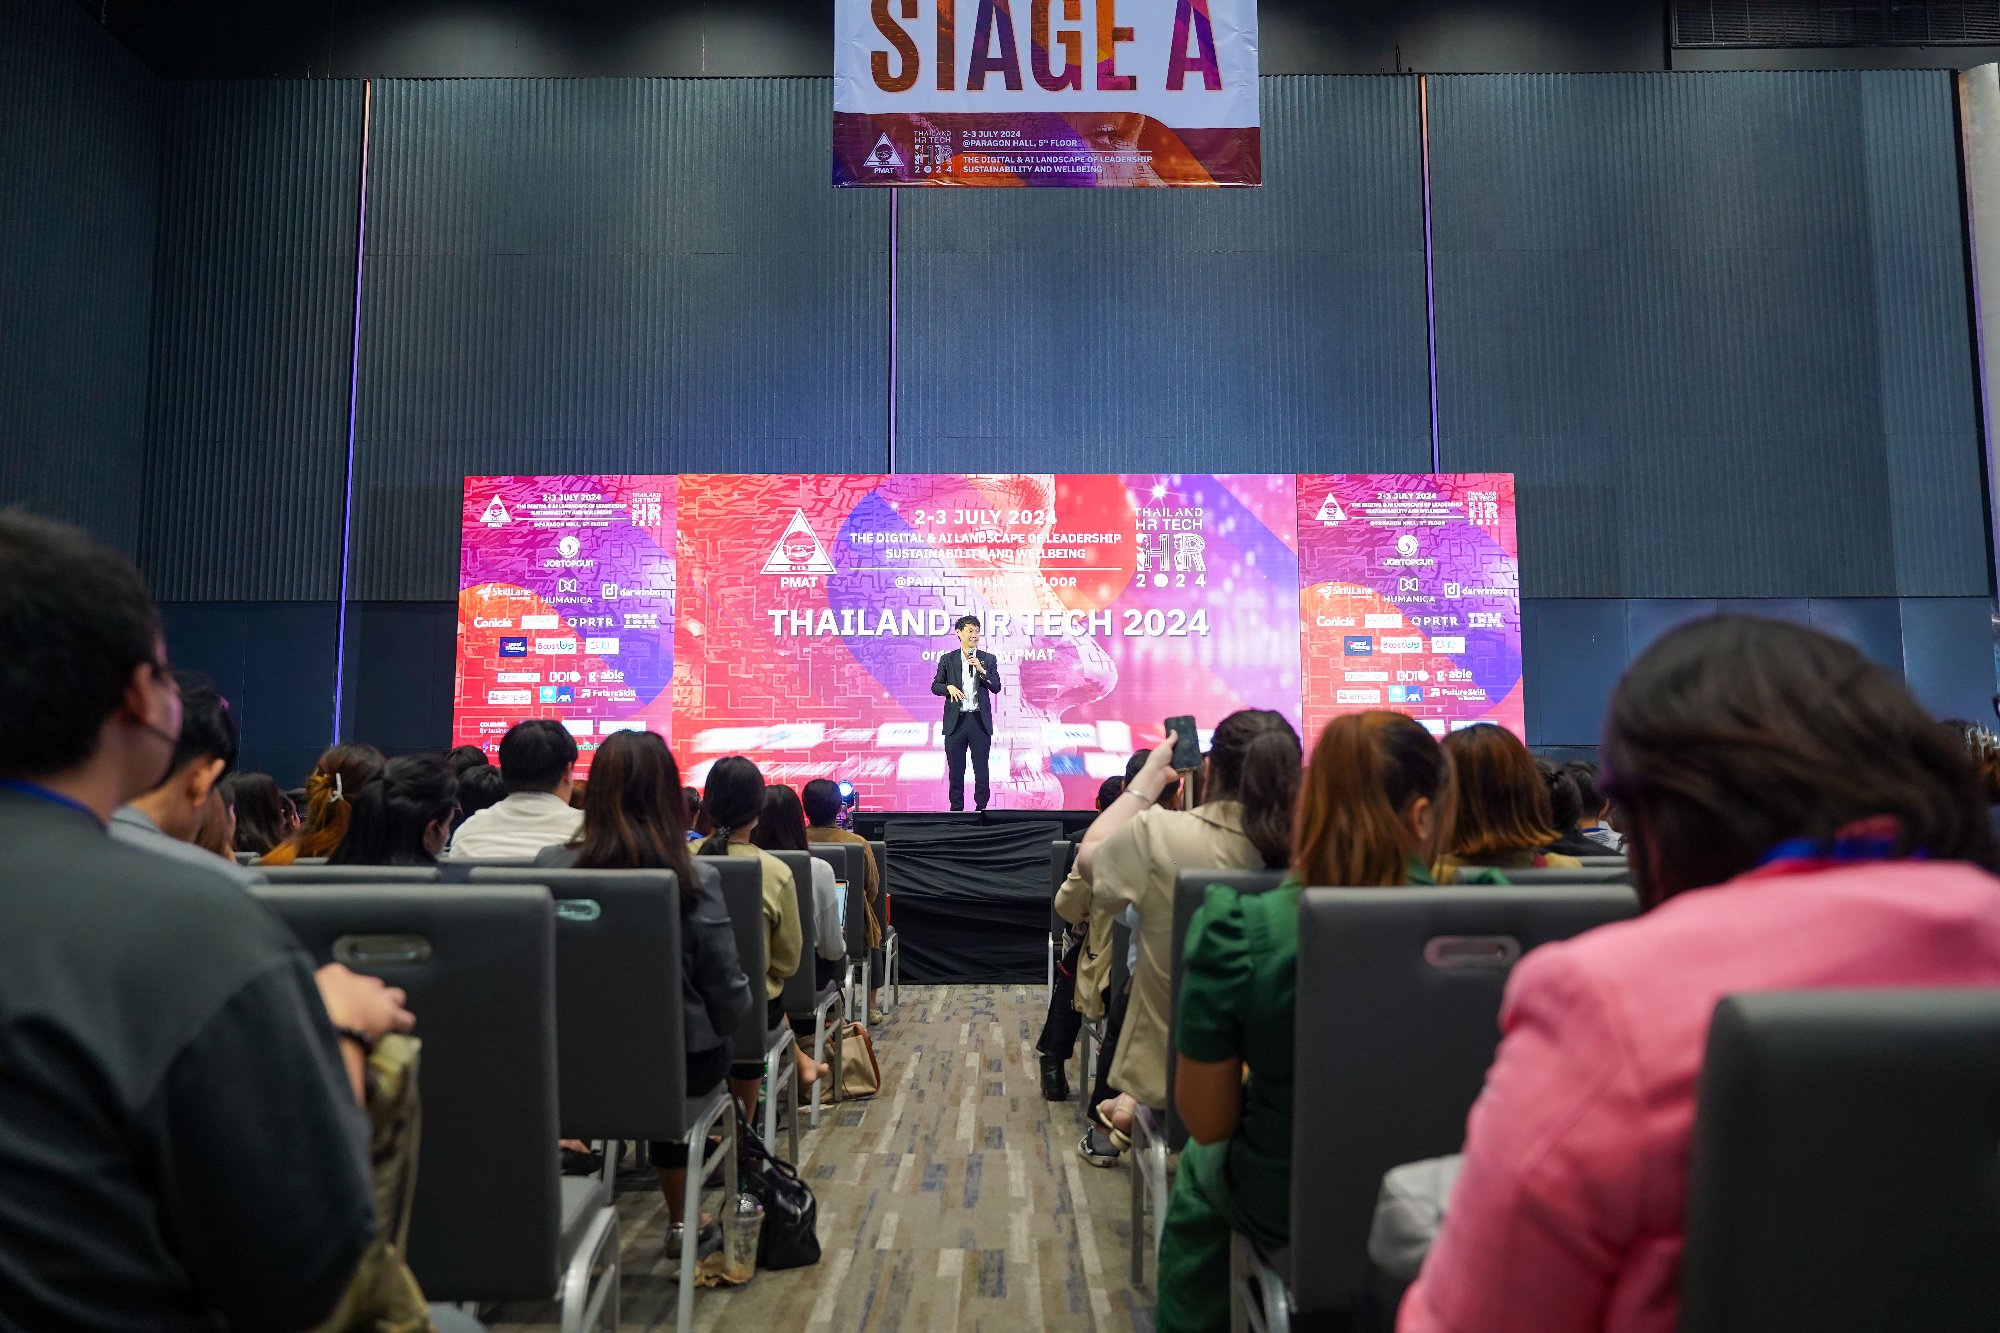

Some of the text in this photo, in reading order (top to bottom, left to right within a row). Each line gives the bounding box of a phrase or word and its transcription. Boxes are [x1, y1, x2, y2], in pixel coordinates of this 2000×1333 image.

[871, 0, 1221, 92] STAGE A
[962, 140, 1010, 148] @PARAGON
[1012, 140, 1036, 148] HALL,
[560, 493, 579, 502] JULY
[581, 493, 602, 502] 2024
[1393, 492, 1414, 500] JULY
[1416, 492, 1437, 500] 2024
[914, 510, 1058, 524] 2-3 JULY 2024
[1135, 508, 1204, 517] THAILAND
[1136, 519, 1202, 530] HR TECH
[850, 533, 1122, 544] THE DIGITAL & AI LANDSCAPE OF LEADERSHIP
[885, 548, 1086, 560] SUSTAINABILITY AND WELLBEING
[781, 577, 818, 588] PMAT
[895, 576, 971, 588] @PARAGON
[580, 618, 614, 626] PRTR
[768, 609, 951, 636] THAILAND
[1022, 609, 1112, 636] TECH
[1123, 609, 1210, 636] 2024
[1424, 616, 1458, 626] PRTR
[1468, 612, 1504, 628] IBM
[1015, 649, 1056, 661] PMAT
